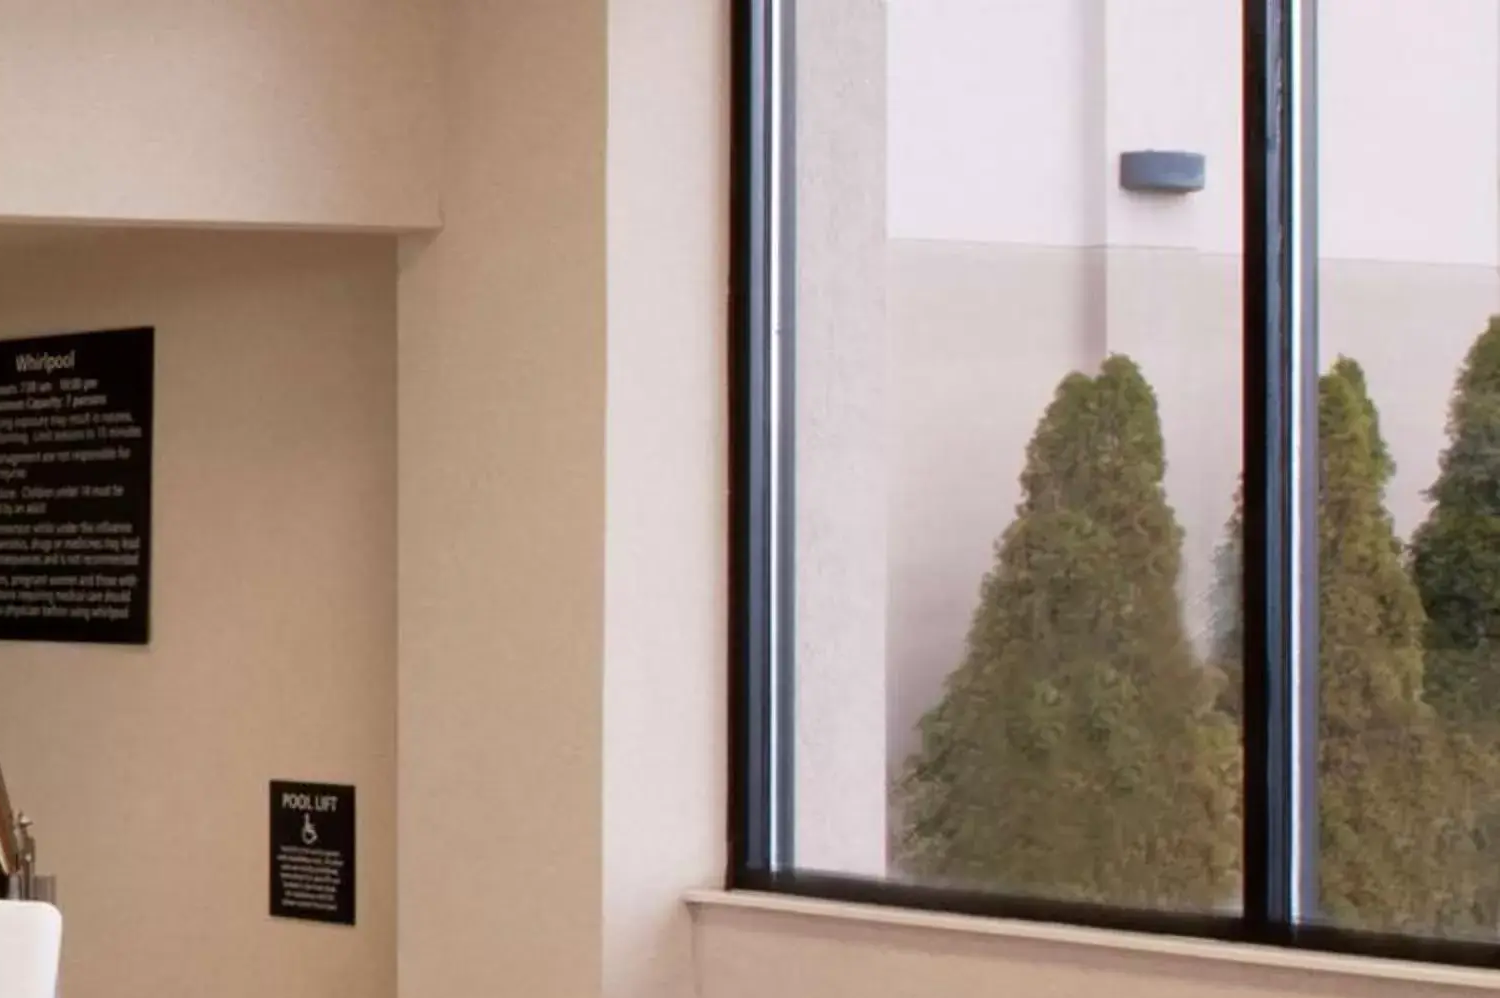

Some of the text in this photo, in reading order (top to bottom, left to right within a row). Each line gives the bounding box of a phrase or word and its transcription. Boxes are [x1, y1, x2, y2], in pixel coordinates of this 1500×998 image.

[16, 349, 75, 374] Whirlpool
[282, 792, 338, 812] POOL LIFT
